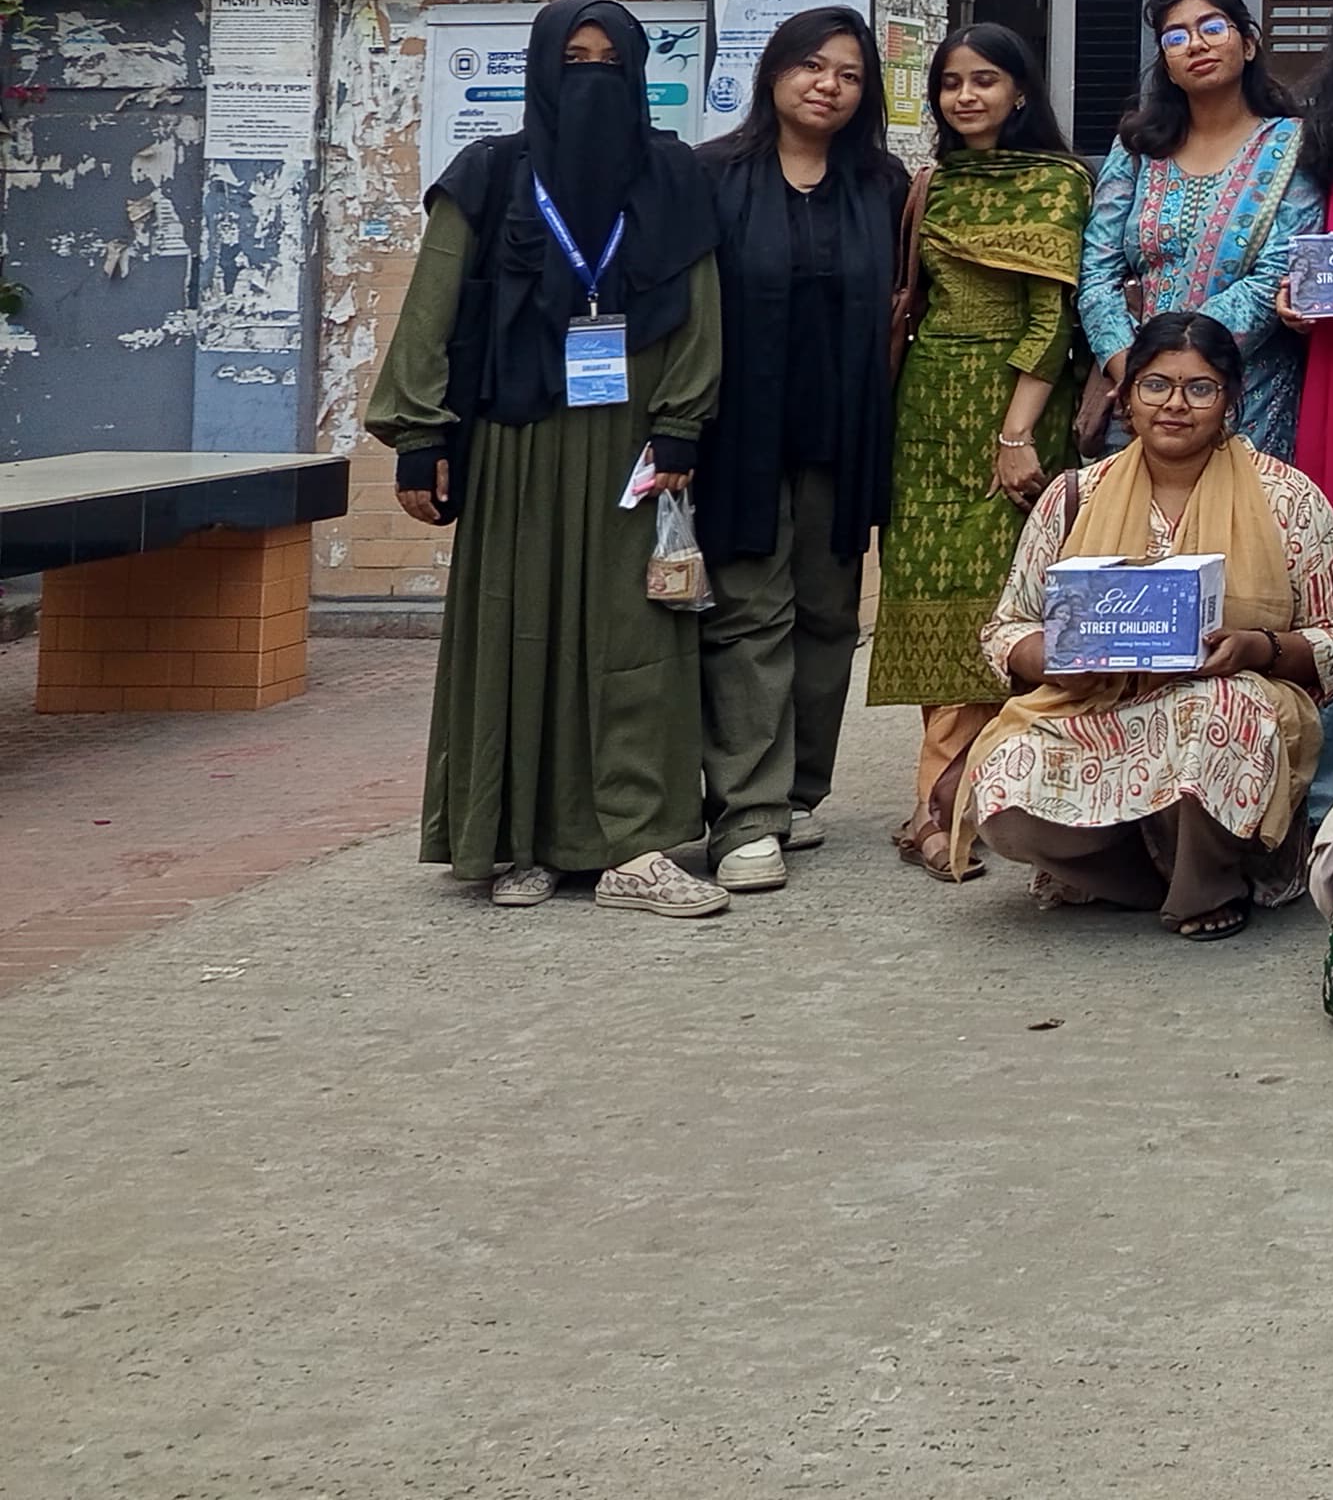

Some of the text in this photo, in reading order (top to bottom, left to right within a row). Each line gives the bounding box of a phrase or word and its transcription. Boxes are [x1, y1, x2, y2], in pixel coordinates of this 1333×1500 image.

[1095, 585, 1149, 618] Eid
[1080, 621, 1169, 634] STREET CHILDREN
